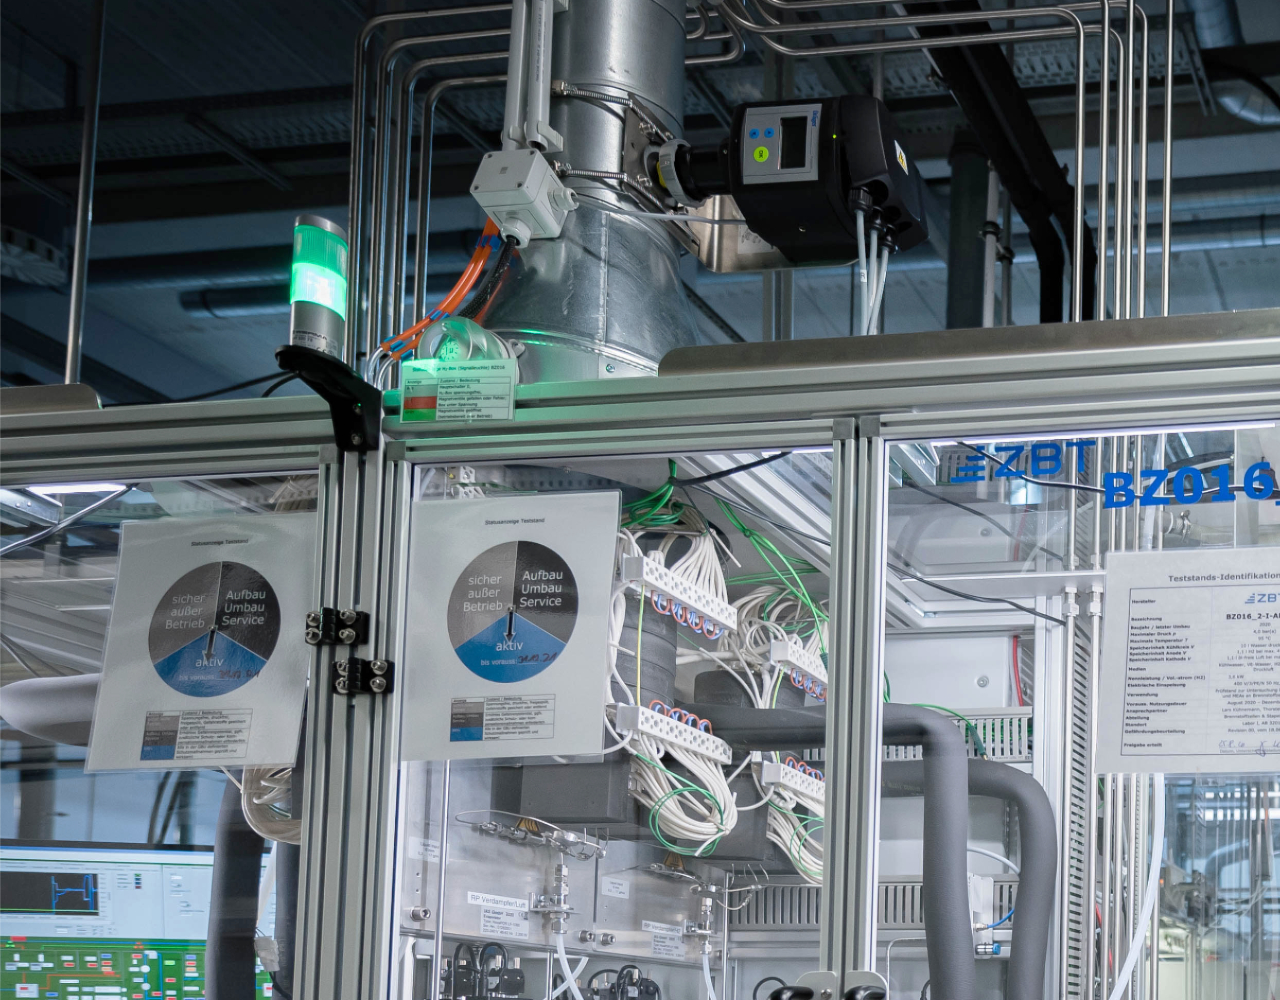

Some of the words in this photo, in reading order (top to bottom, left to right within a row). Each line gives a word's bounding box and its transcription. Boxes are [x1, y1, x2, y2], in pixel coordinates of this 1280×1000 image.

[759, 150, 763, 158] OK
[994, 440, 1096, 479] ZBT
[469, 575, 502, 585] sicher
[523, 571, 563, 580] Aufbau
[468, 588, 500, 598] außer
[522, 584, 562, 594] Umbau
[172, 594, 205, 604] sicher
[226, 590, 266, 600] Aufbau
[464, 601, 502, 611] Betrieb
[520, 597, 562, 607] Service
[171, 606, 203, 616] außer
[224, 603, 264, 613] Umbau
[165, 619, 205, 629] Betrieb
[222, 616, 264, 626] Service
[496, 641, 523, 651] aktiv
[196, 658, 224, 667] aktiv
[482, 897, 526, 908] Verdampfer/Luft
